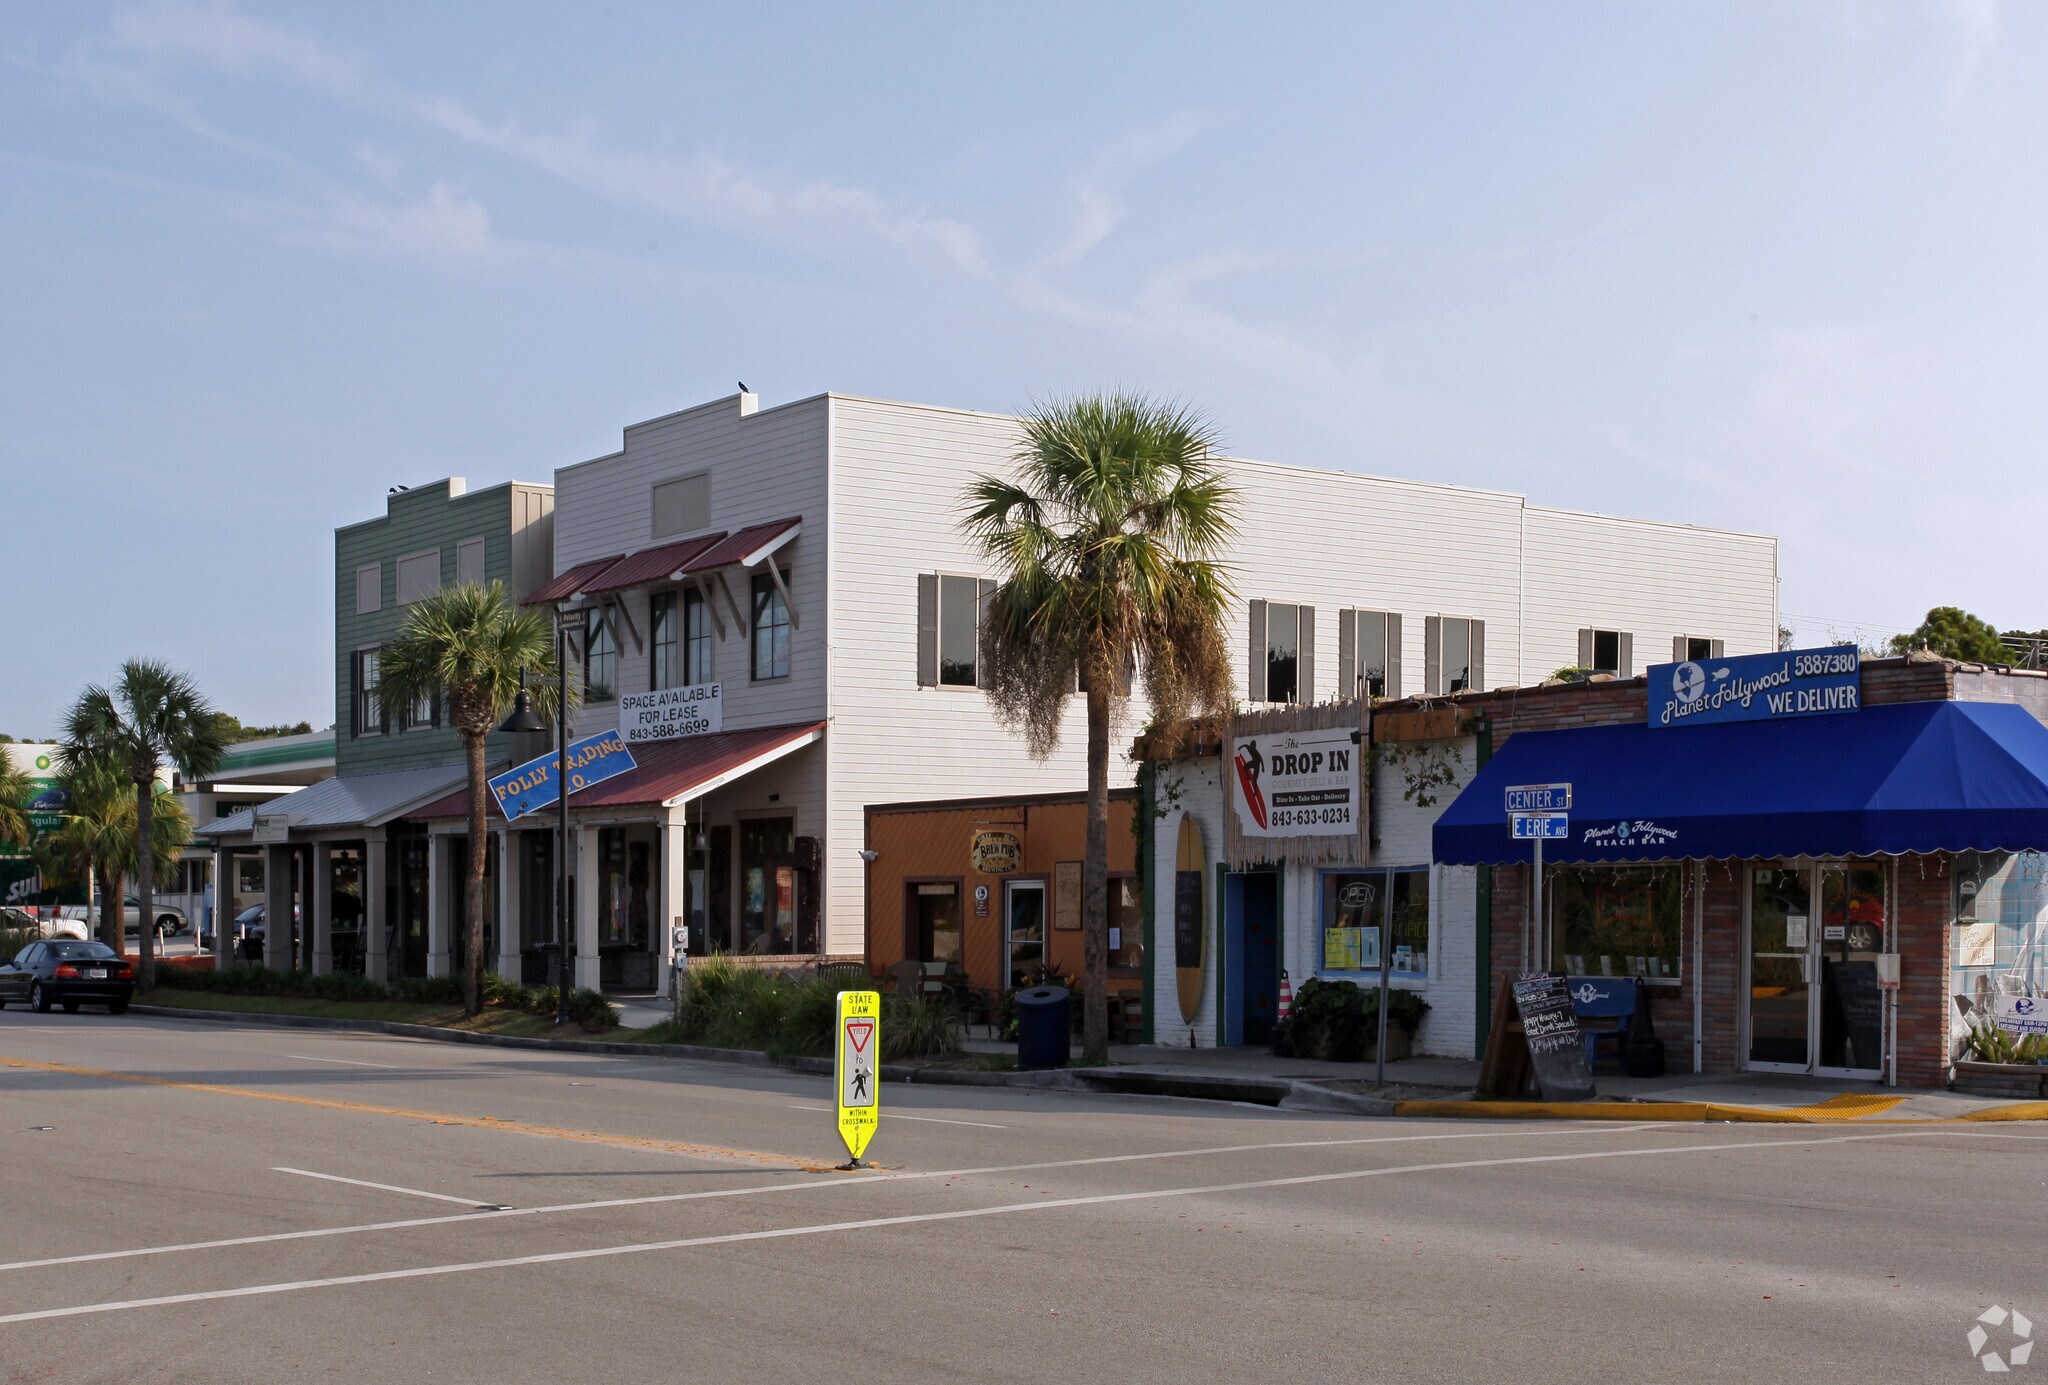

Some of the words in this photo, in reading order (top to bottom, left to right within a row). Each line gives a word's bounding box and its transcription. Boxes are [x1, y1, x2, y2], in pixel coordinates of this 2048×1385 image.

[622, 694, 656, 710] SPACE
[658, 684, 719, 705] AVAILABLE
[1661, 693, 1710, 725] Planet
[1711, 662, 1790, 709] Follywood
[1794, 654, 1856, 677] 588-7380
[1767, 691, 1794, 714] WE
[1797, 685, 1858, 712] DELIVER
[639, 708, 660, 724] FOR
[662, 705, 698, 722] LEASE
[629, 718, 709, 740] 843-588-6699
[1284, 738, 1300, 749] The
[1271, 752, 1323, 776] DROP
[1328, 750, 1350, 772] IN
[495, 766, 549, 801] FOLLY
[1272, 779, 1307, 789] GOURMET
[1309, 777, 1325, 787] DELI
[1335, 776, 1349, 785] BAR
[1324, 793, 1346, 802] Delivery
[1508, 790, 1552, 809] CENTER
[1556, 797, 1564, 806] ST
[1271, 807, 1350, 827] 843-633-0234
[1514, 818, 1521, 836] E
[1526, 818, 1551, 836] ERIE
[1555, 826, 1566, 836] AVE
[1583, 825, 1616, 843] Planet
[1631, 820, 1678, 840] Follywood
[1596, 838, 1635, 846] BEACH
[1641, 837, 1665, 845] BAR
[980, 843, 1000, 859] BREW
[1001, 843, 1015, 859] PUB
[1761, 870, 1767, 880] A
[1339, 887, 1376, 903] OPEN
[849, 995, 873, 1004] STATE
[851, 1005, 869, 1014] LAW
[1999, 1017, 2023, 1025] BREAKFAST
[852, 1027, 867, 1035] YIELD
[842, 1117, 874, 1125] CROSSWALK
